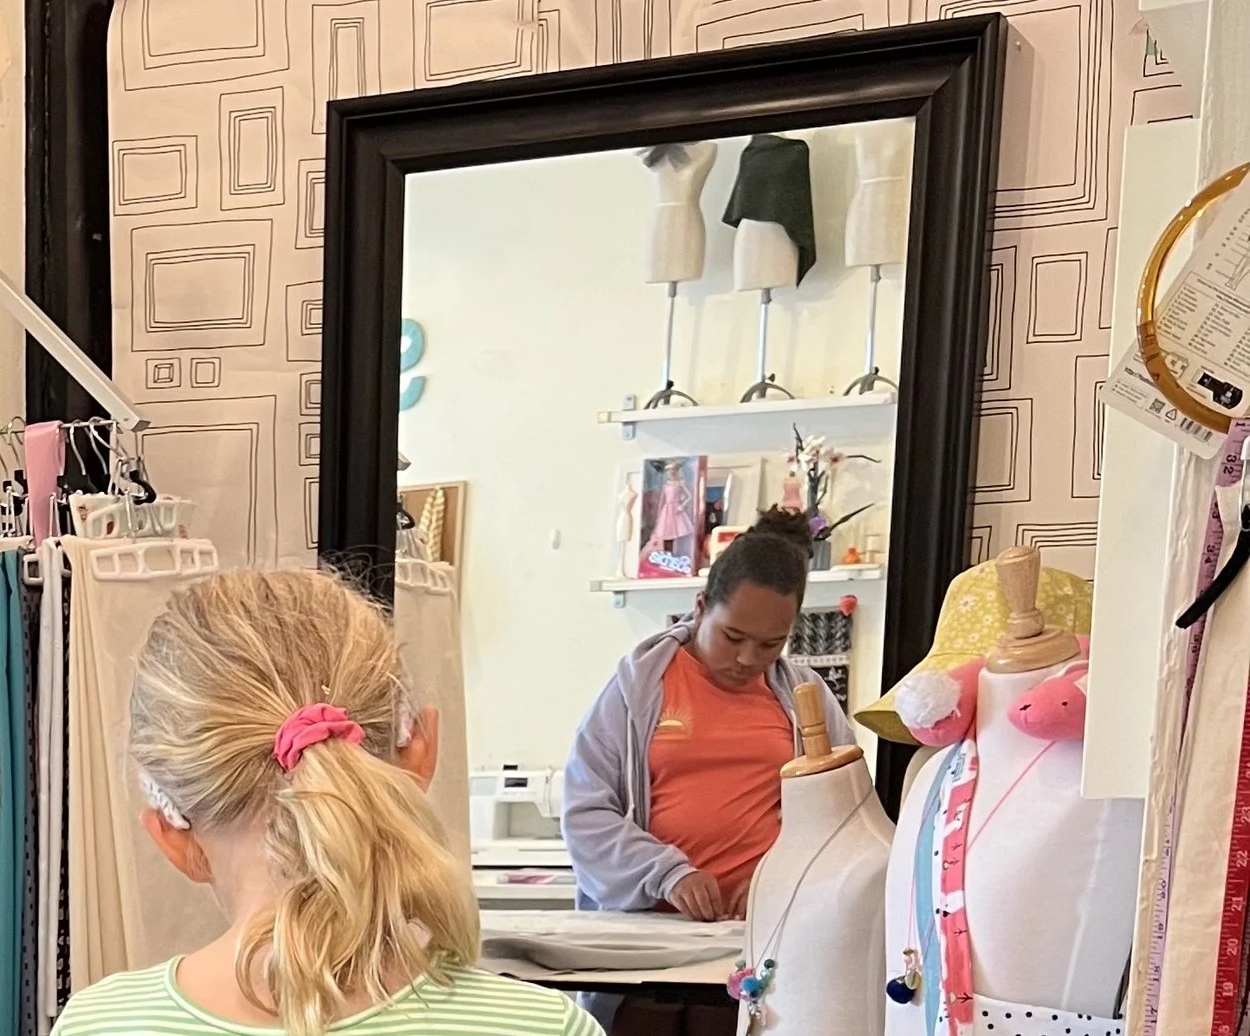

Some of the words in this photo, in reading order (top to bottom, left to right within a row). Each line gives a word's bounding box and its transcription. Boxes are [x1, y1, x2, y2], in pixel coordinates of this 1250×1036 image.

[1235, 850, 1248, 868] 22
[1231, 896, 1244, 912] 21
[1226, 938, 1239, 956] 20
[1222, 981, 1234, 997] 19
